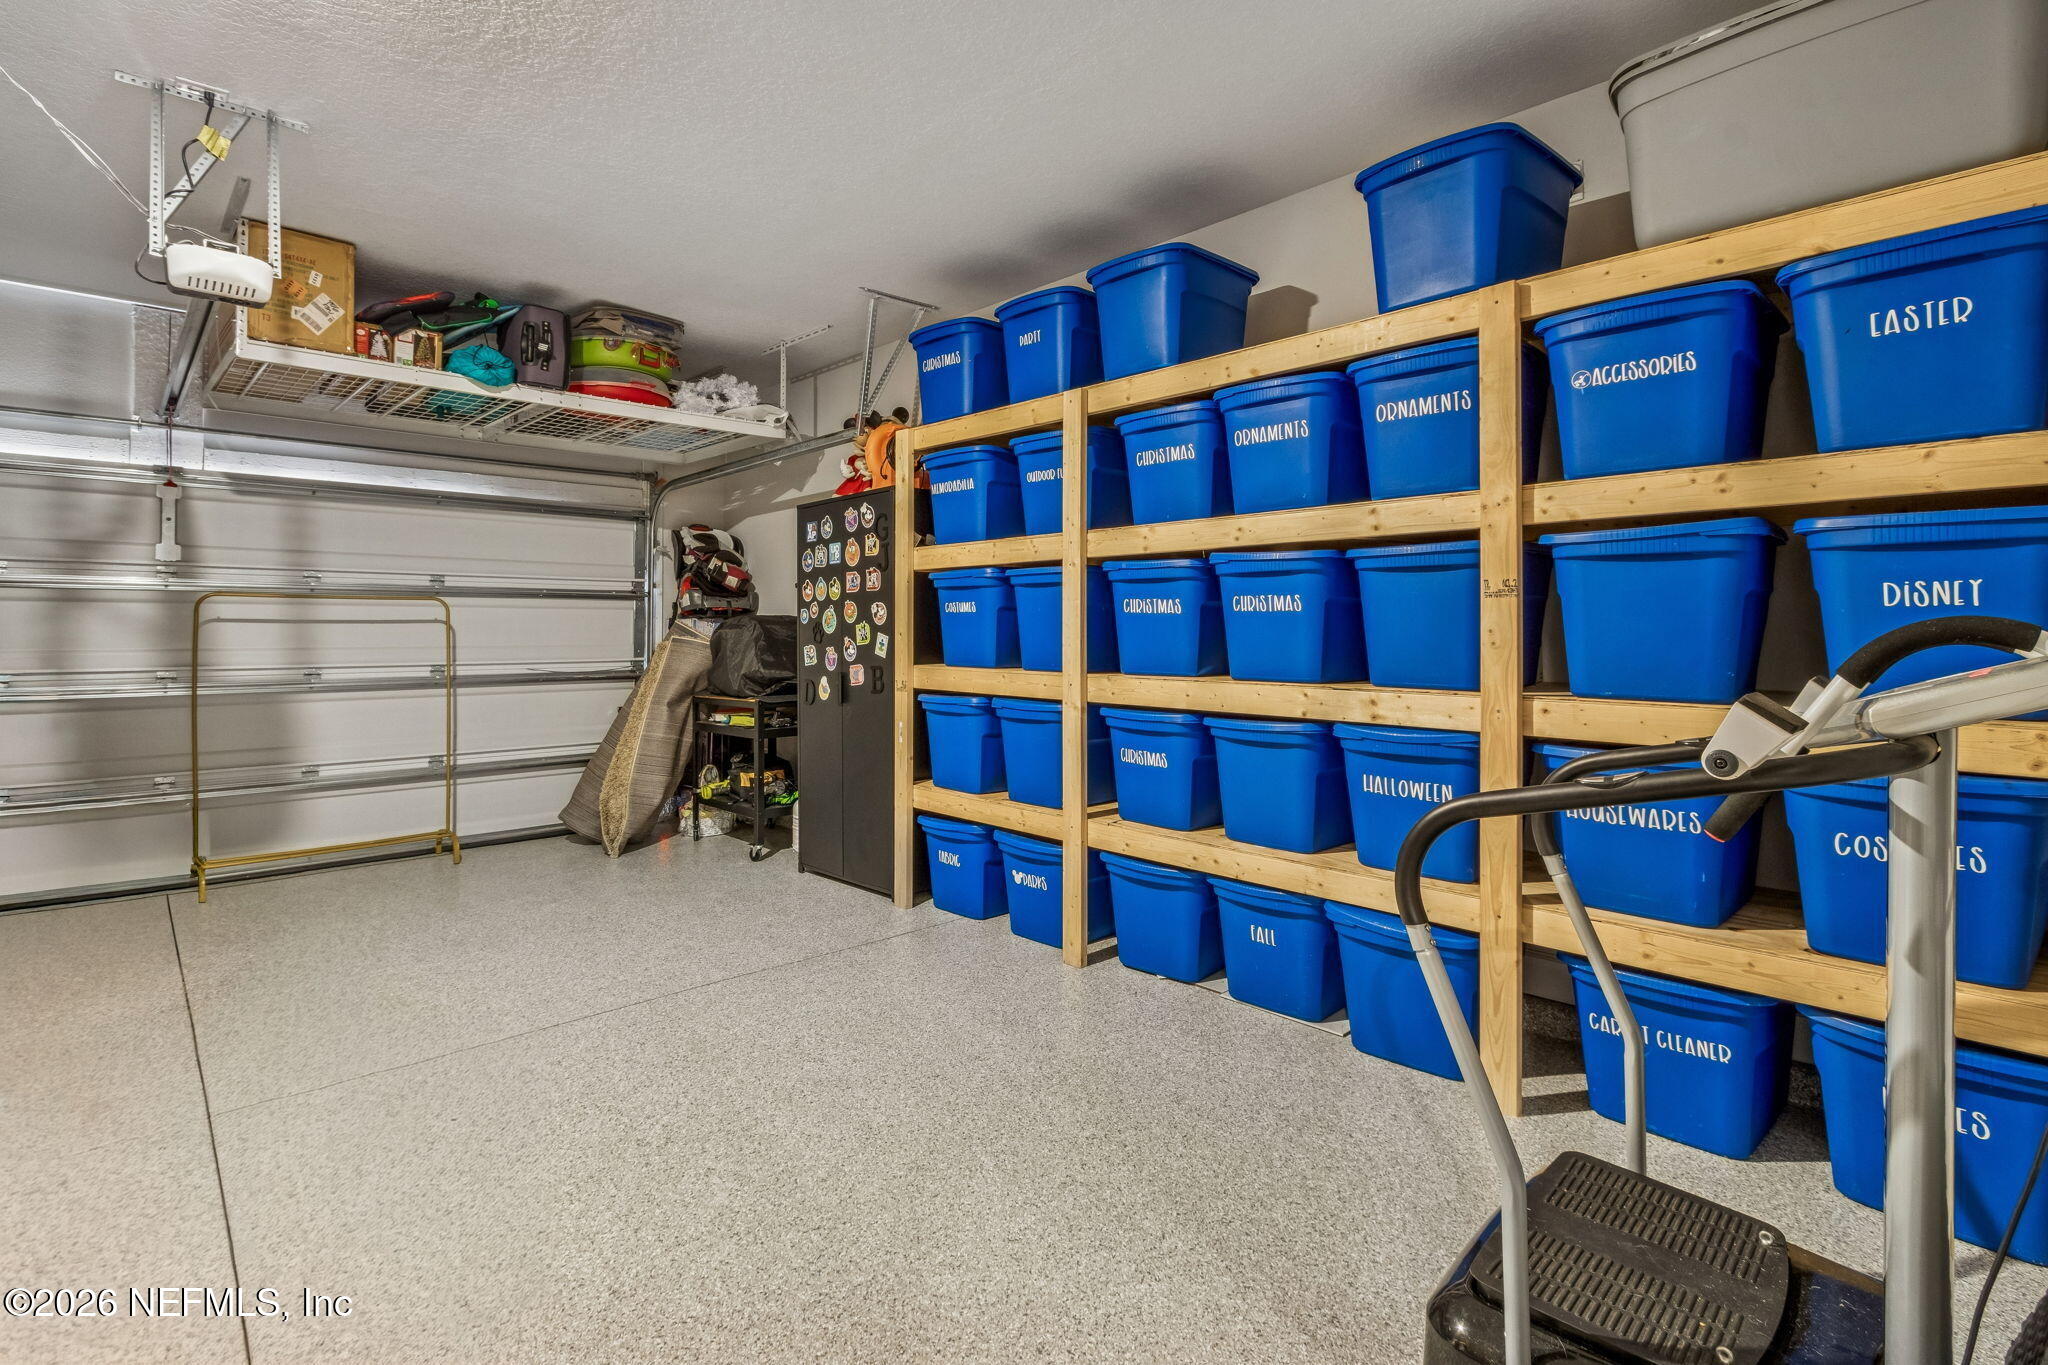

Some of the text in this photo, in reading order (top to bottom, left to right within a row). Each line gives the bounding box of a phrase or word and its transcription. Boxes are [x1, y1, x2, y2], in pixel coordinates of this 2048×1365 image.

[1869, 296, 1973, 338] EASTER
[1019, 329, 1041, 346] PARTY
[922, 350, 961, 373] CHRISTMAS
[1592, 350, 1697, 387] ACCESSORIES
[1375, 389, 1472, 423] ORNAMENTS
[1234, 419, 1309, 447] ORNAMENTS
[1136, 443, 1195, 467] CHRISTMAS
[1026, 468, 1056, 483] OUTDOOR
[1232, 594, 1303, 613] CHRISTMAS
[1882, 578, 1983, 608] DISNEY
[944, 601, 977, 614] COSTUMES
[1123, 598, 1182, 615] CHRISTMAS
[1120, 747, 1168, 769] CHRISTMAS
[1363, 773, 1453, 804] HALLOWEEN
[938, 849, 961, 868] FABRIC
[1022, 872, 1048, 891] PARKS
[1250, 924, 1277, 947] FALL
[1656, 1030, 1732, 1065] CLEANER
